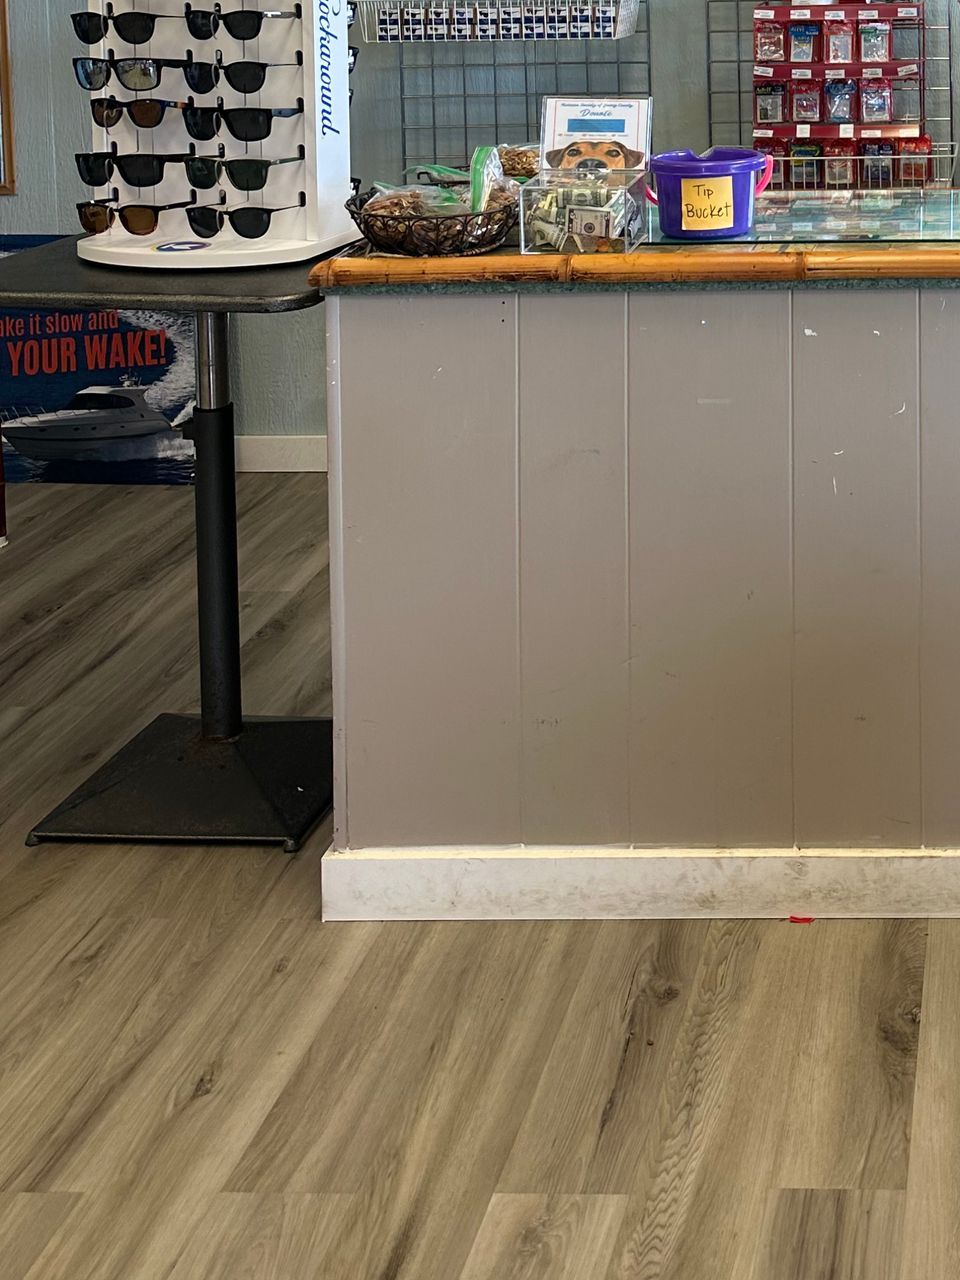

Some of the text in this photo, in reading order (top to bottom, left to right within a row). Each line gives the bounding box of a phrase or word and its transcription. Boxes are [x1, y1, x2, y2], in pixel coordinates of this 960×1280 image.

[684, 202, 732, 219] Bucket
[29, 313, 41, 335] it
[46, 312, 83, 334] slow
[88, 309, 119, 331] and
[7, 328, 167, 377] YOUR WAKE!
